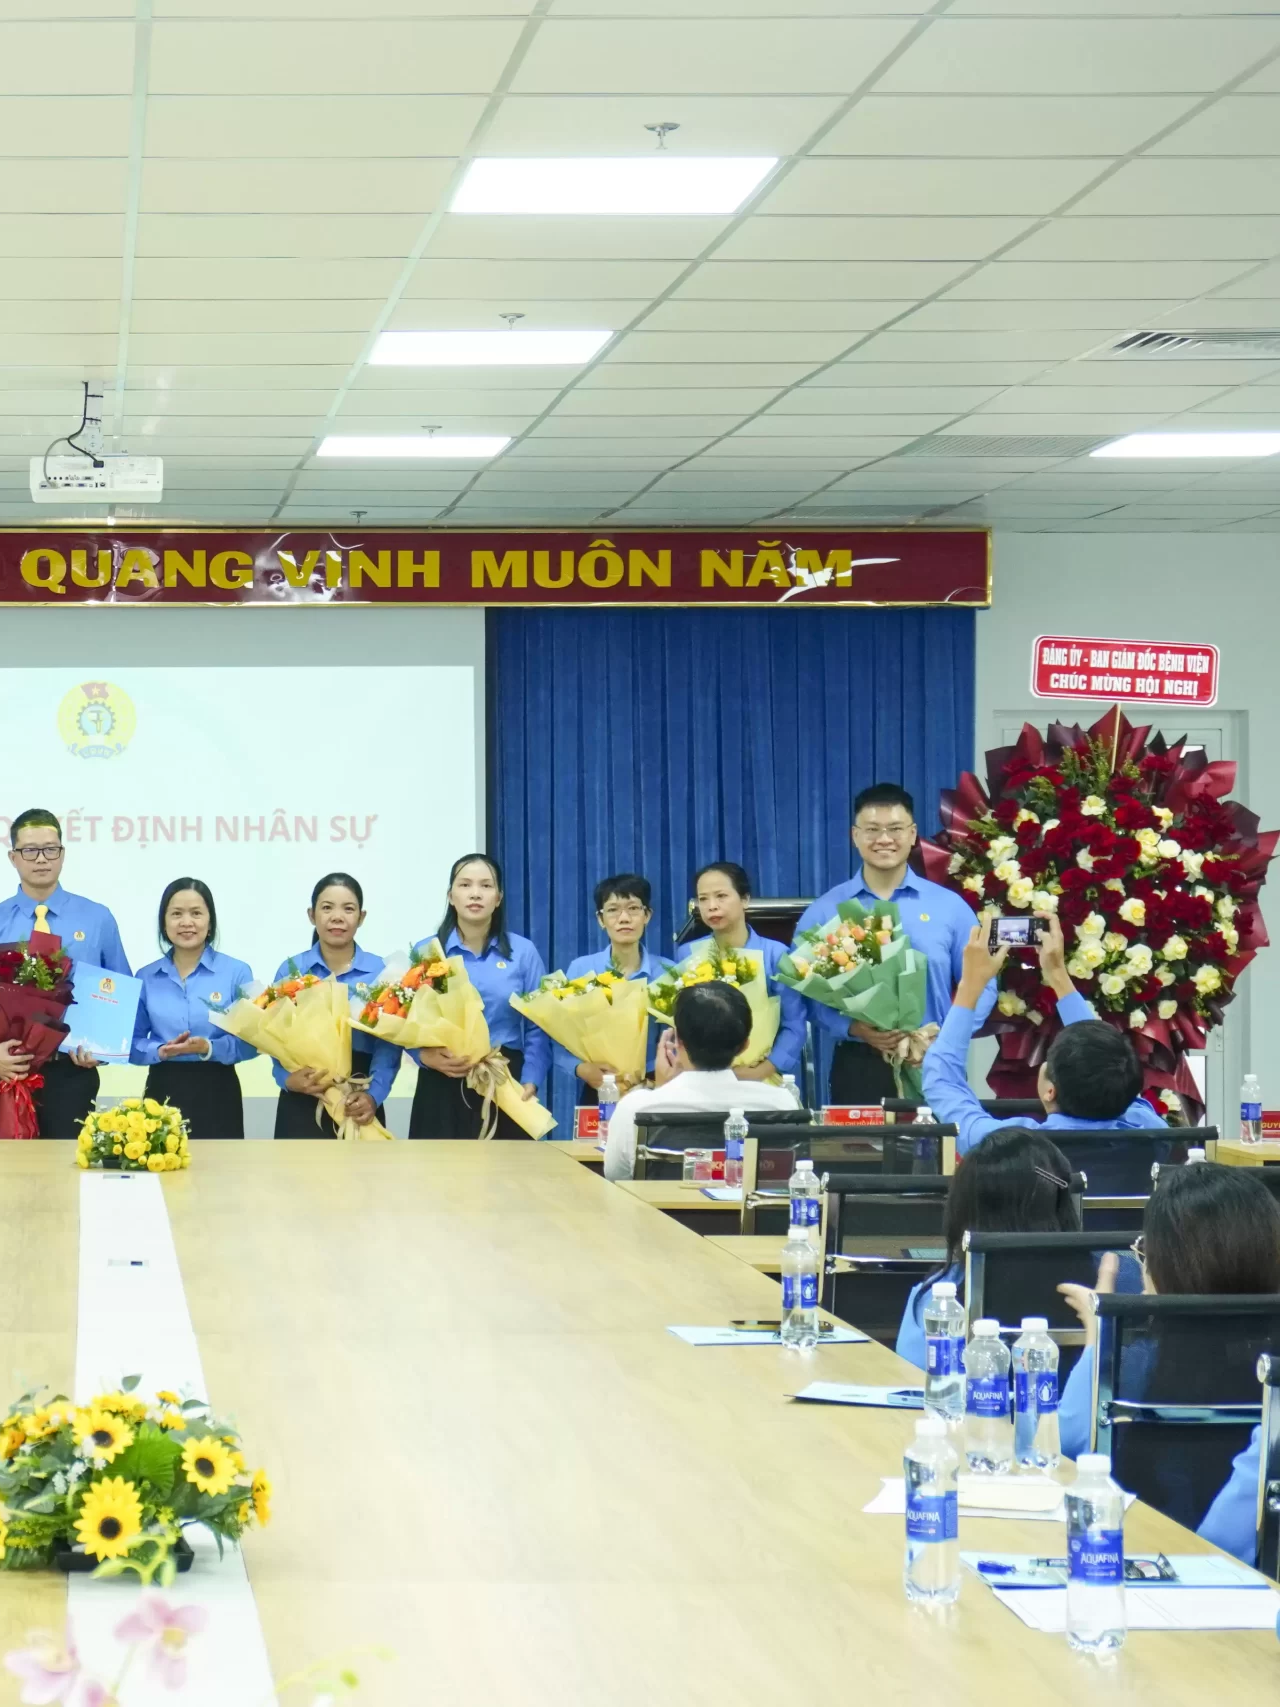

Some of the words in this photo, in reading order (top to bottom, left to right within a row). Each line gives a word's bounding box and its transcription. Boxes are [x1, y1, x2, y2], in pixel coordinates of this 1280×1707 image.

[20, 548, 254, 594] QUANG
[277, 550, 441, 589] VINH
[471, 539, 673, 589] MUÔN
[701, 540, 853, 588] NĂM
[1042, 643, 1068, 667] ĐẢNG
[1090, 649, 1111, 669] BAN
[1137, 647, 1157, 671] ĐỐC
[1158, 649, 1185, 675] BỆNH
[1186, 651, 1210, 677] VIỆN
[1050, 671, 1088, 691] CHÚC
[1091, 673, 1132, 693] MỪNG
[1135, 675, 1160, 697] HỘI
[1163, 679, 1199, 699] NGHỊ
[111, 814, 204, 850] ĐỊNH
[216, 808, 318, 843] NHÂN
[330, 813, 380, 850] SỰ
[973, 1391, 1005, 1402] AQUAFINA
[906, 1509, 942, 1524] AQUAFINA
[1080, 1552, 1121, 1566] AQUAFINA
